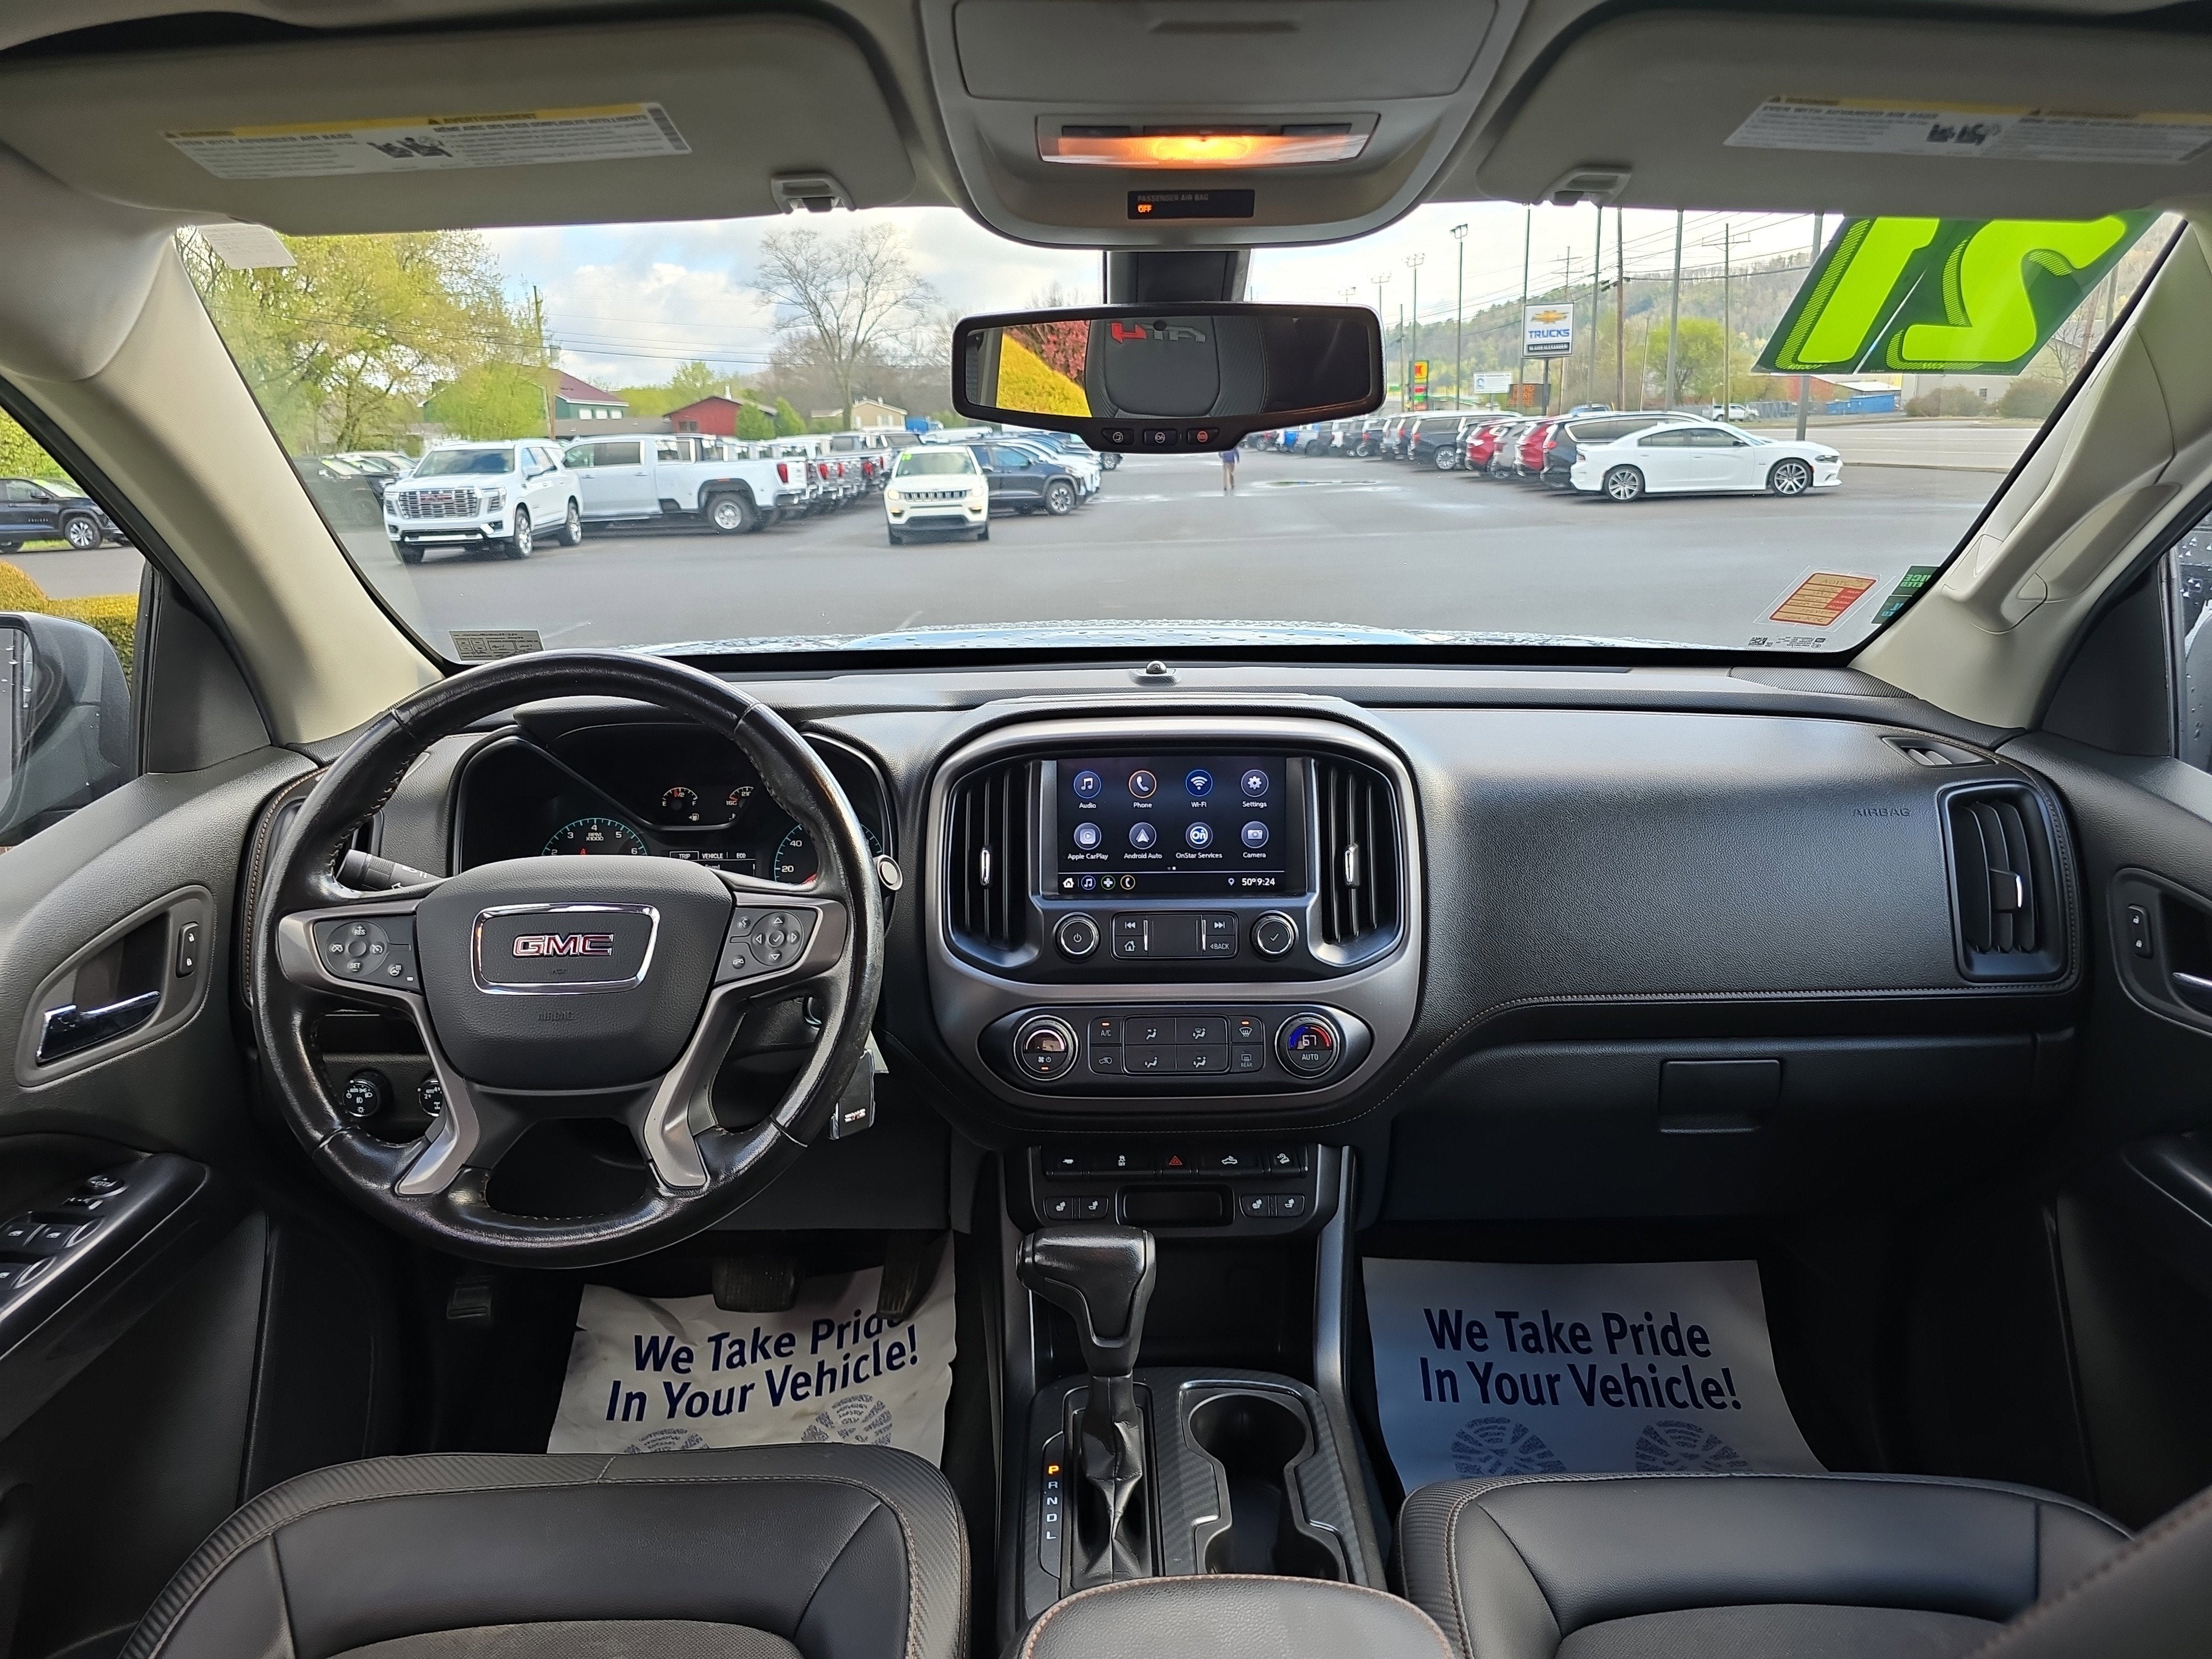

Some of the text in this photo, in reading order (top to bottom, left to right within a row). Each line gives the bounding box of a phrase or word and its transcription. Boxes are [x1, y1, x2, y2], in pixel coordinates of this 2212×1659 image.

[1137, 204, 1153, 213] OFF
[1528, 329, 1570, 339] TRUCKS
[1853, 808, 1911, 816] AIRBAG
[789, 839, 802, 847] 40
[1257, 877, 1276, 886] 9:24
[513, 934, 614, 956] GMC
[1214, 942, 1230, 950] BACK
[1302, 1035, 1316, 1046] 67
[1423, 1308, 1711, 1358] We Take Pride
[634, 1334, 695, 1374] We
[708, 1326, 796, 1372] Take
[606, 1323, 919, 1422] In Your Vehicle!
[1419, 1356, 1742, 1411] In Your Vehicle!
[1048, 1465, 1059, 1474] P
[1048, 1481, 1058, 1489] R
[1046, 1497, 1058, 1505] N
[1046, 1514, 1057, 1522] D
[1046, 1531, 1056, 1540] L
